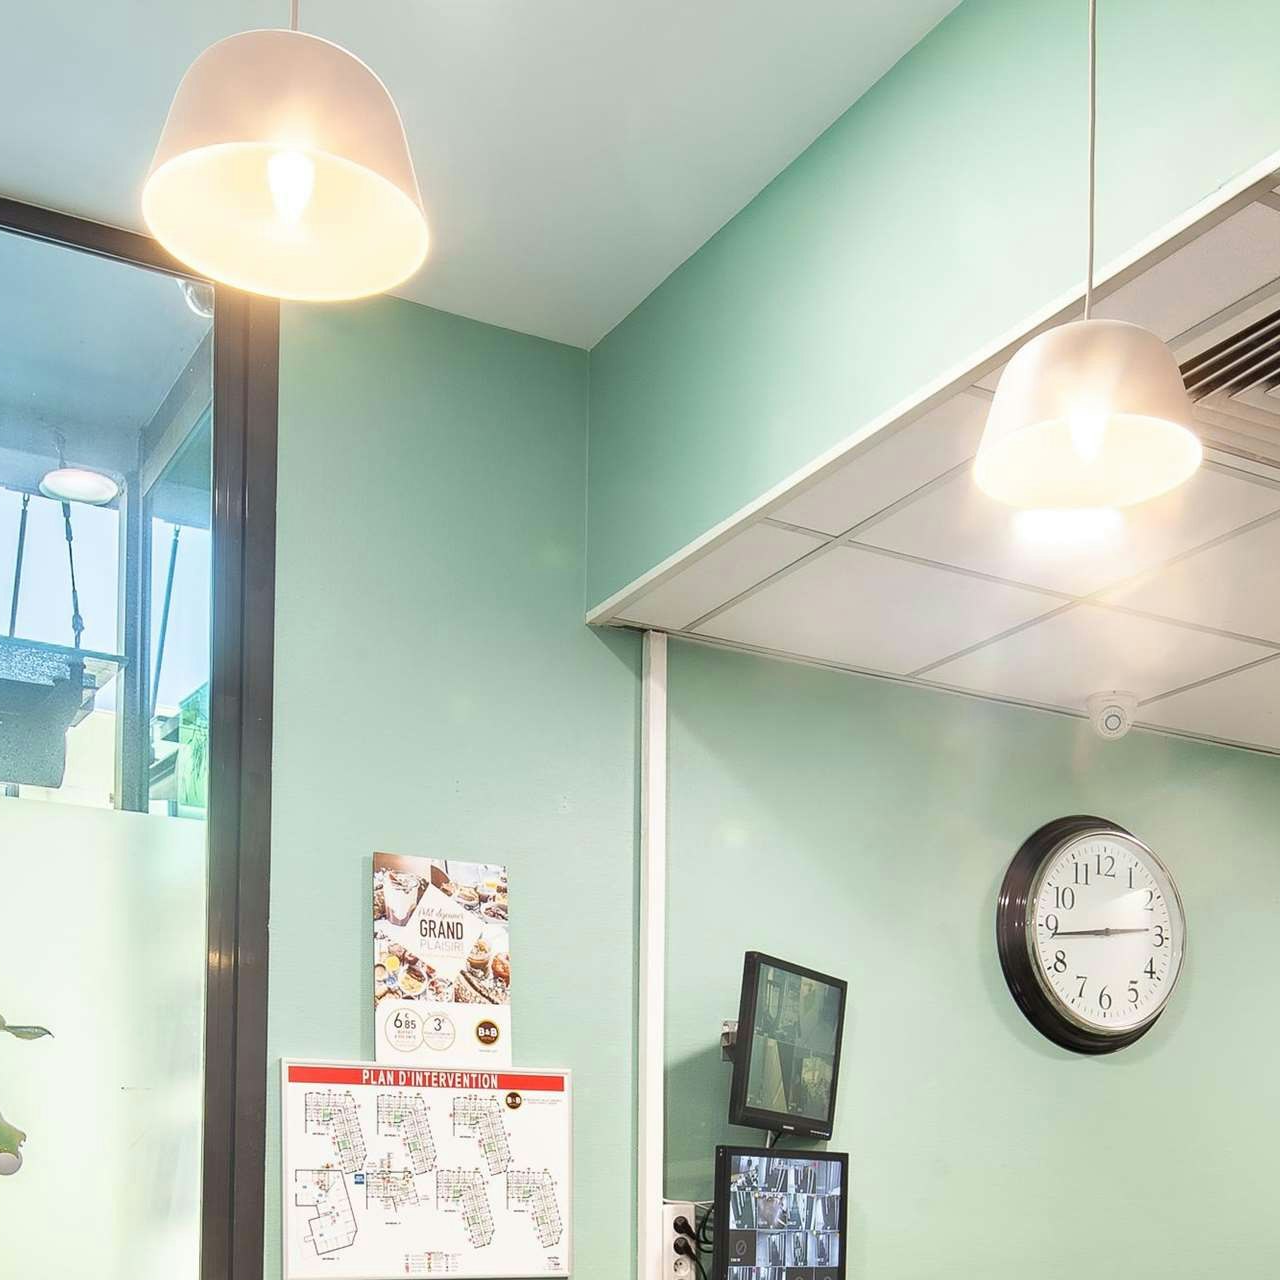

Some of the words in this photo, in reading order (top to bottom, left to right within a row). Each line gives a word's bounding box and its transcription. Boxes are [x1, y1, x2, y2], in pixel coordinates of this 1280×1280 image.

[1074, 862, 1090, 885] 11
[1096, 854, 1115, 878] 12
[1127, 867, 1135, 889] 1
[1054, 886, 1075, 910] 10
[1144, 891, 1154, 911] 2
[420, 919, 463, 940] GRAND
[1046, 914, 1059, 939] 9
[1152, 925, 1164, 947] 3
[1054, 950, 1067, 973] 8
[1144, 957, 1156, 979] 4
[1076, 976, 1087, 998] 7
[1099, 985, 1112, 1010] 6
[1128, 980, 1138, 1003] 5
[362, 1070, 394, 1085] PLAN
[399, 1071, 498, 1088] D'INTERVENTION
